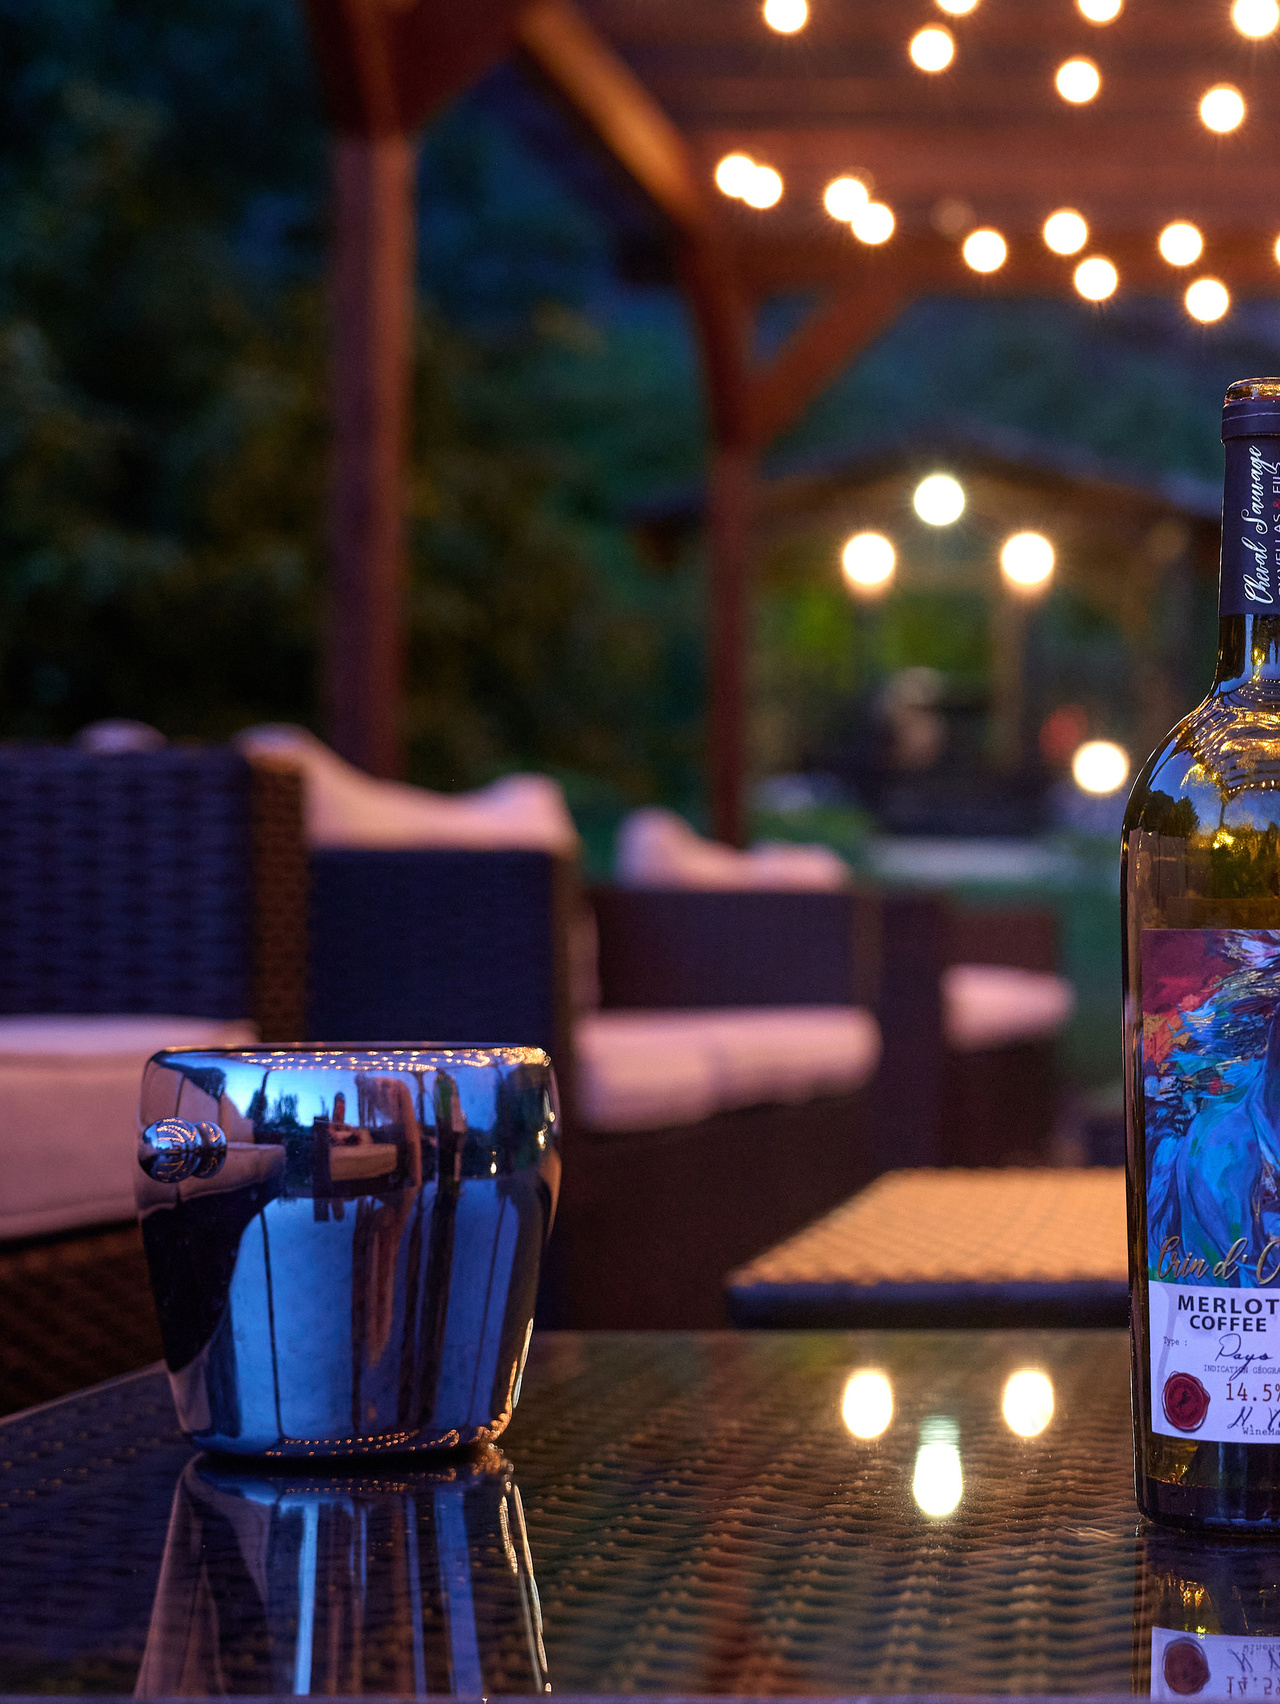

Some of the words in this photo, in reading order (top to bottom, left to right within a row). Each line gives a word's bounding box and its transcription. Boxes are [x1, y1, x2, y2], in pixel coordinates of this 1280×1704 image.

[1241, 445, 1278, 535] Sauvage
[1241, 537, 1274, 604] Cheval
[1158, 1235, 1210, 1279] Crin
[1177, 1294, 1280, 1315] MERLOT
[1189, 1315, 1267, 1332] COFFEE
[1214, 1332, 1274, 1381] Pays
